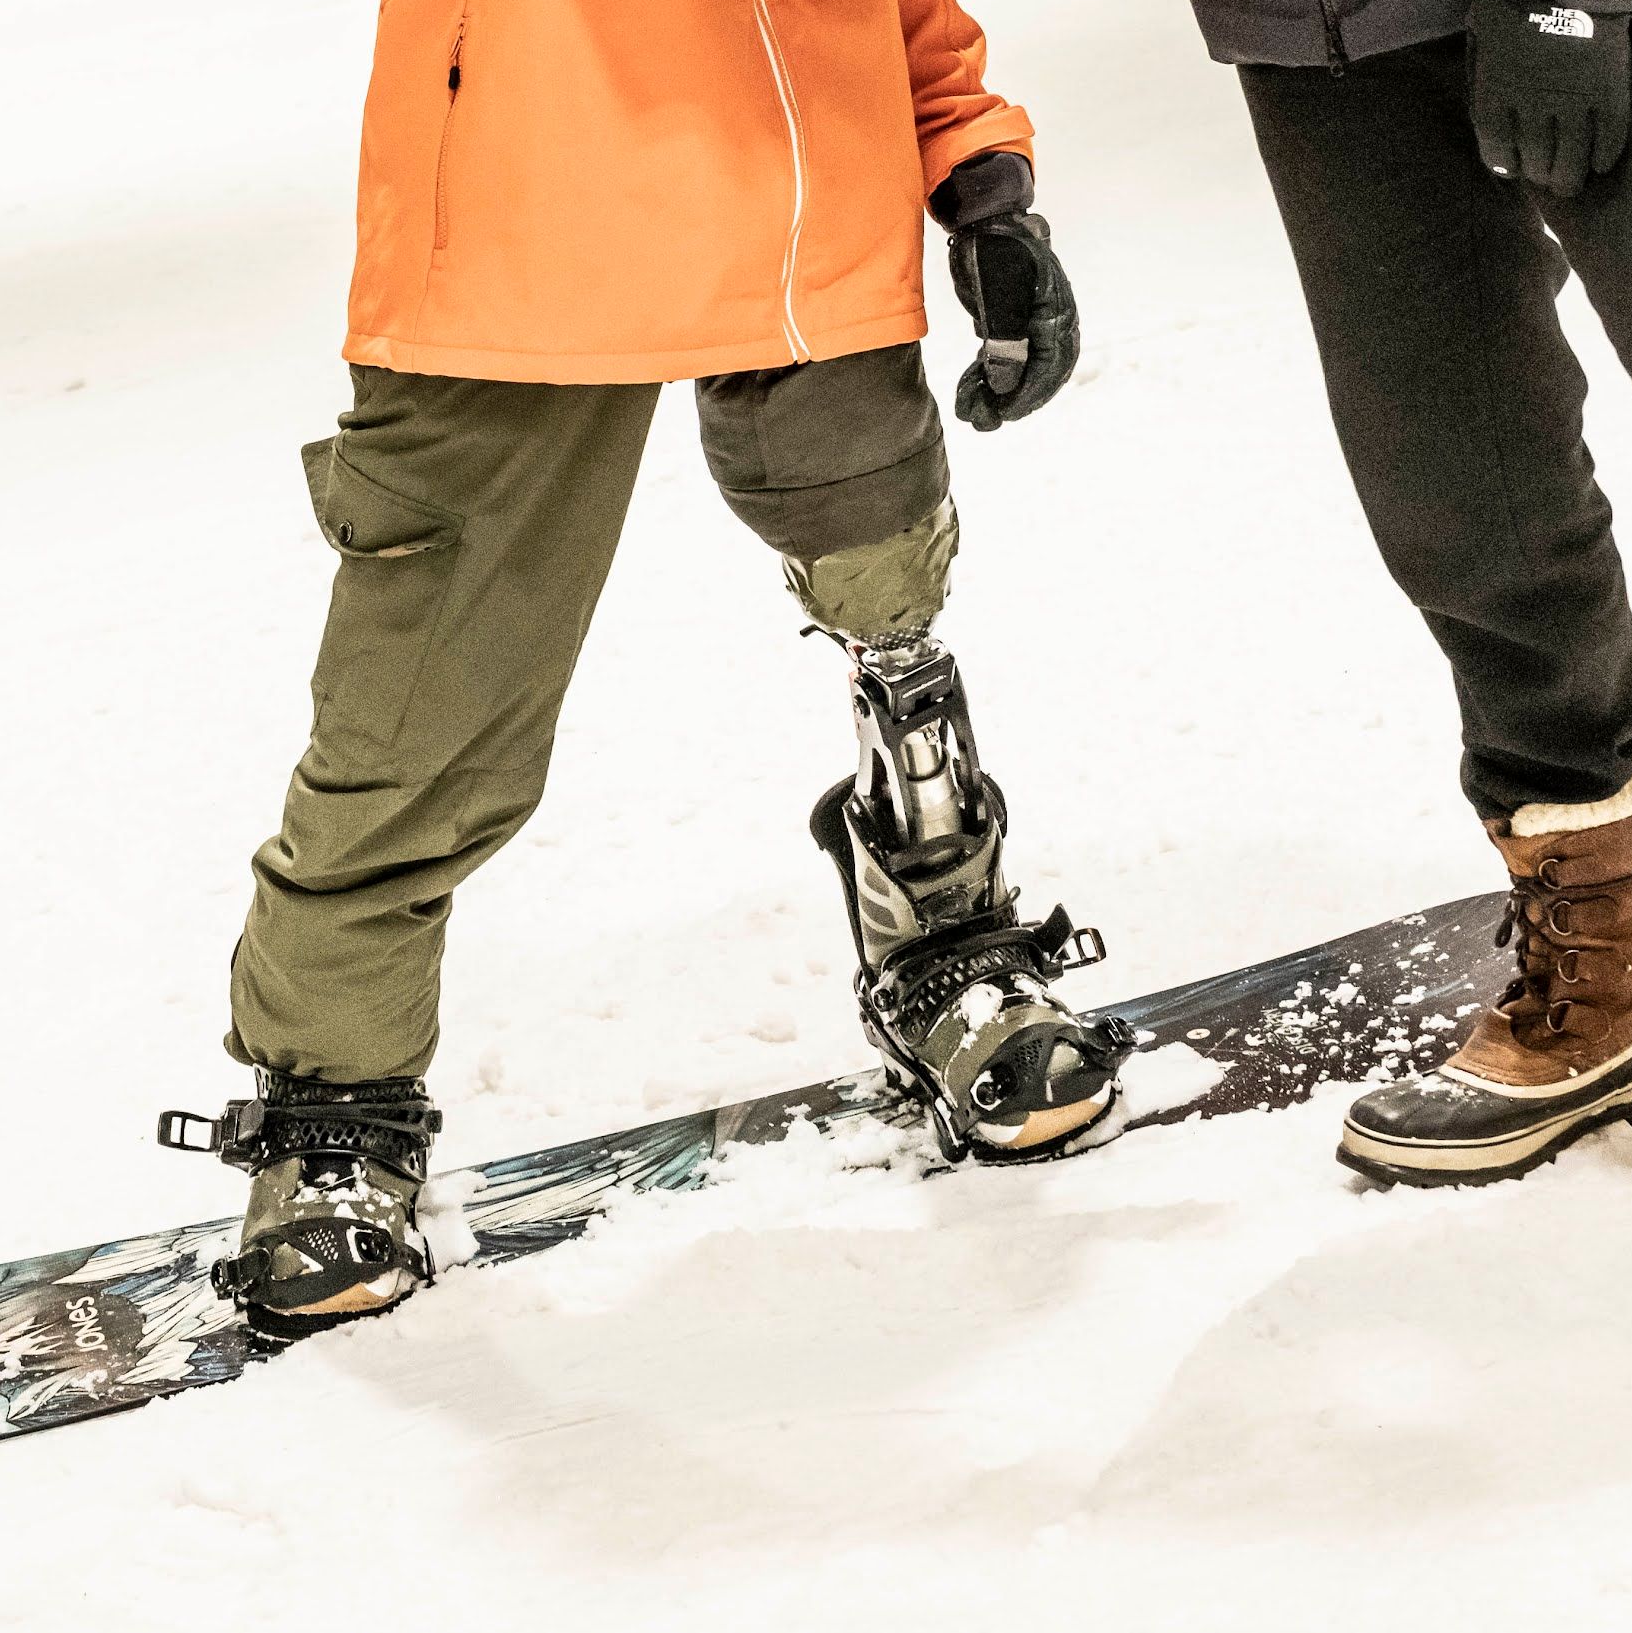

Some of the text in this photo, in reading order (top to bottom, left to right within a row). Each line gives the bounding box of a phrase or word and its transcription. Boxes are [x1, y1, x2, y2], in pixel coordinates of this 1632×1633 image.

[1550, 7, 1576, 18] THE
[1528, 12, 1574, 27] NORTH
[1539, 23, 1574, 36] FACE
